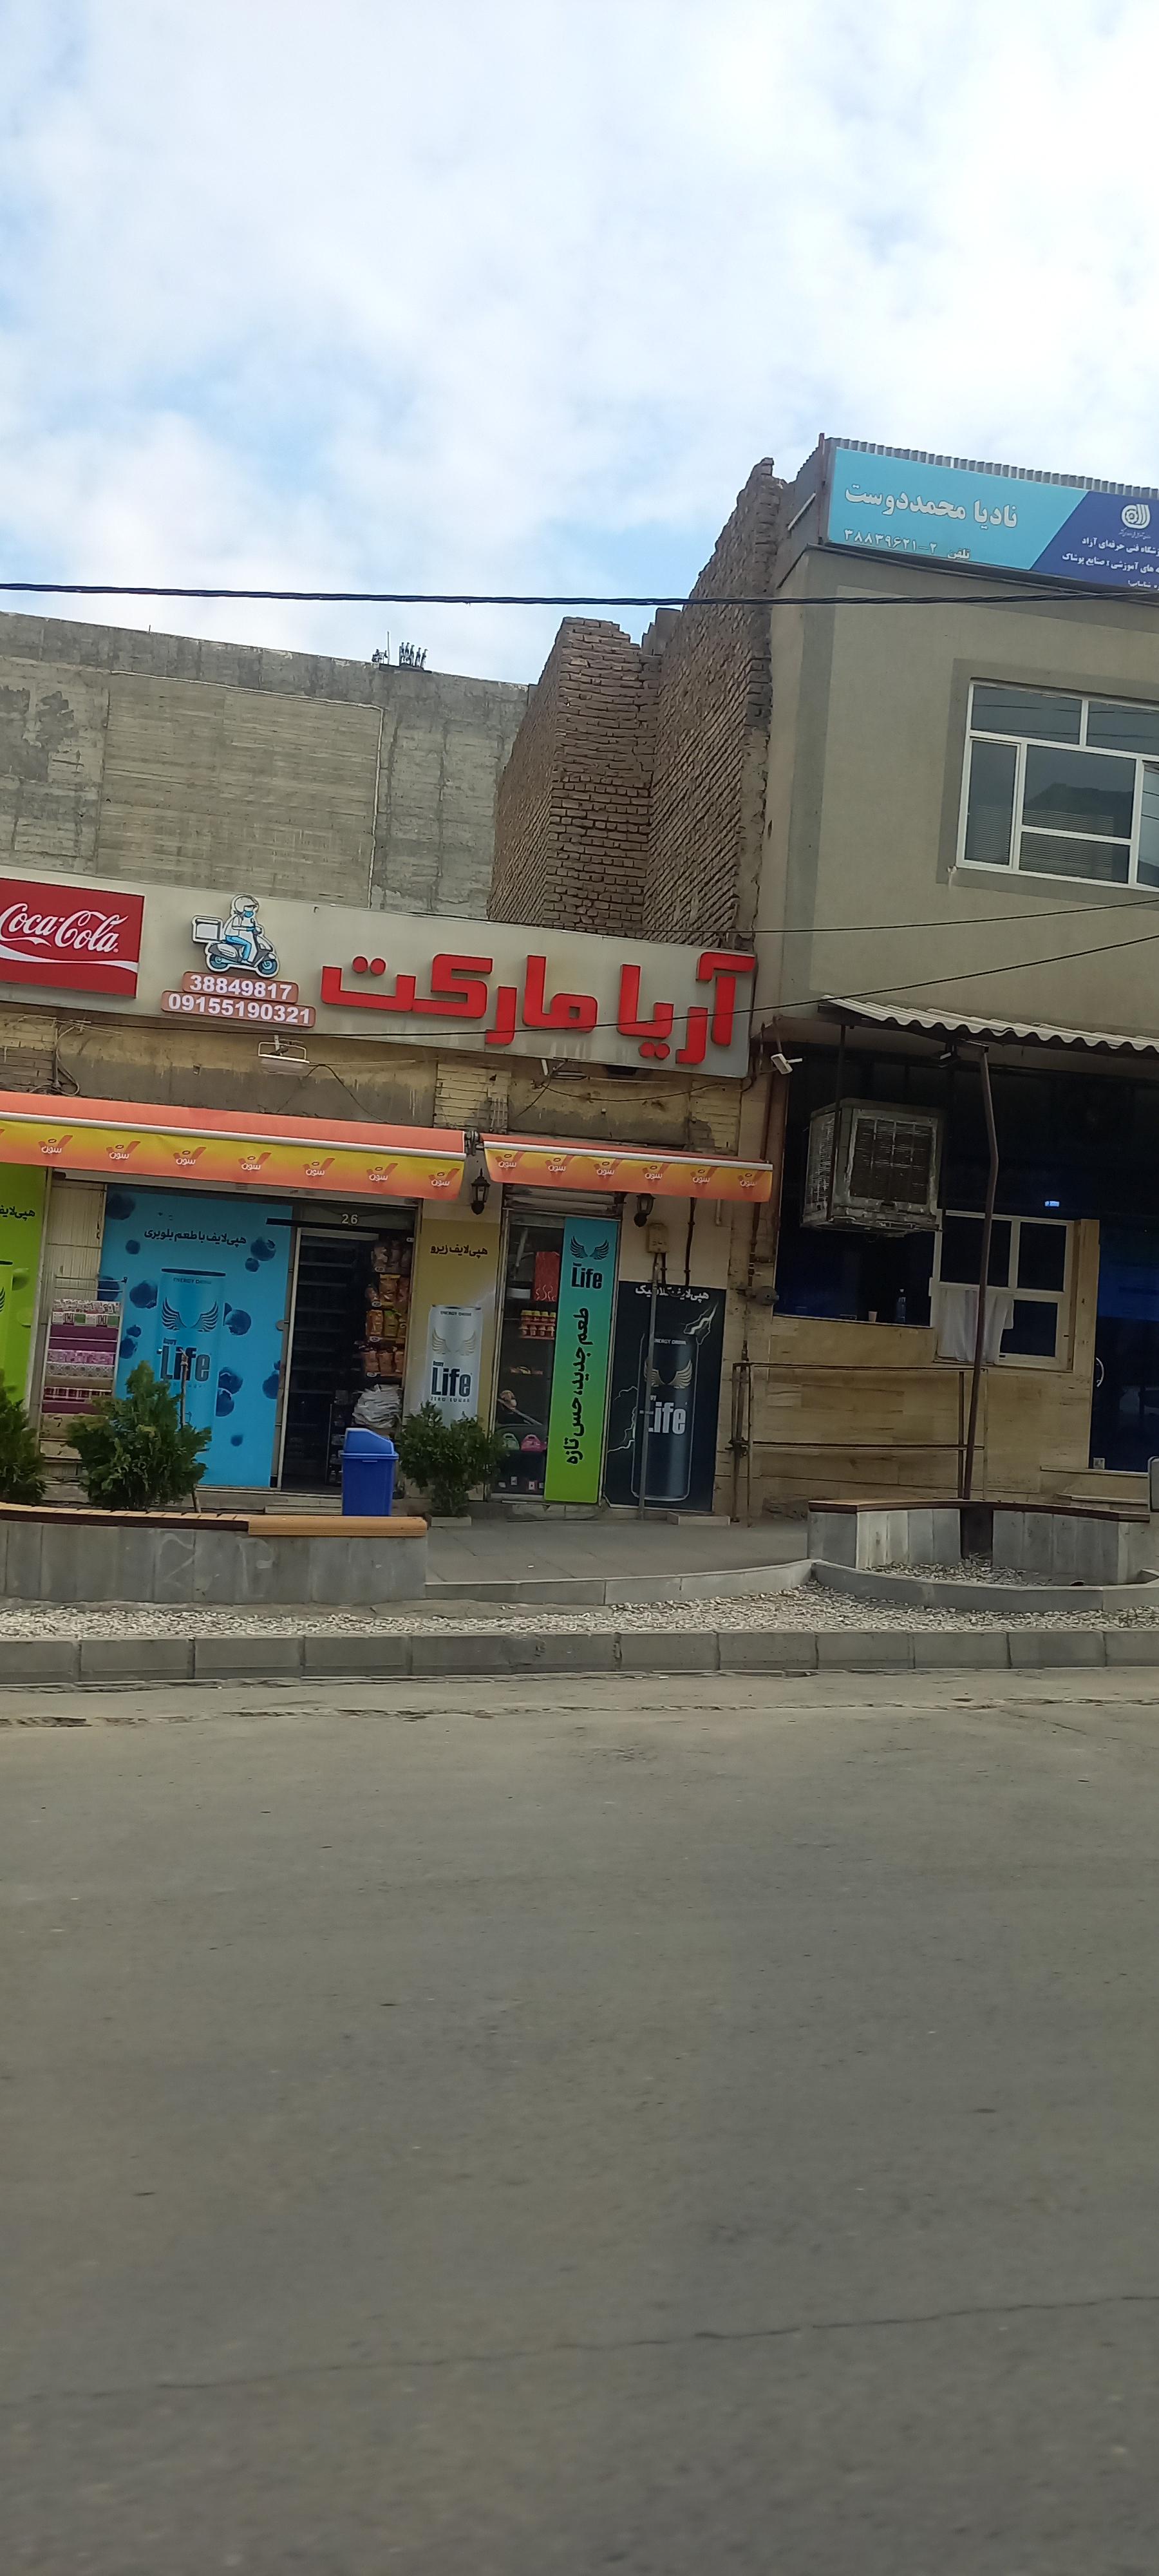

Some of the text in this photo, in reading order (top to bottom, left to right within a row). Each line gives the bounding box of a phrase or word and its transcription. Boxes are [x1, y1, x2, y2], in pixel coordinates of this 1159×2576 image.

[973, 499, 1018, 530] نادیا
[947, 548, 971, 560] تلفن
[1126, 544, 1139, 553] فنی
[0, 902, 129, 953] Coca-Cola
[189, 974, 293, 1001] 38849817
[167, 993, 310, 1025] 09155190321
[321, 951, 756, 1065] آریا مارکت
[341, 1214, 358, 1224] 26
[174, 1230, 198, 1242] طعم
[198, 1231, 205, 1244] با
[430, 1244, 448, 1255] زیرو
[572, 1267, 603, 1289] Life
[572, 1307, 594, 1345] طعم
[160, 1345, 211, 1381] Life
[431, 1367, 471, 1397] Life
[571, 1397, 585, 1437] حس
[648, 1401, 686, 1435] ife
[563, 1437, 584, 1464] تازه
